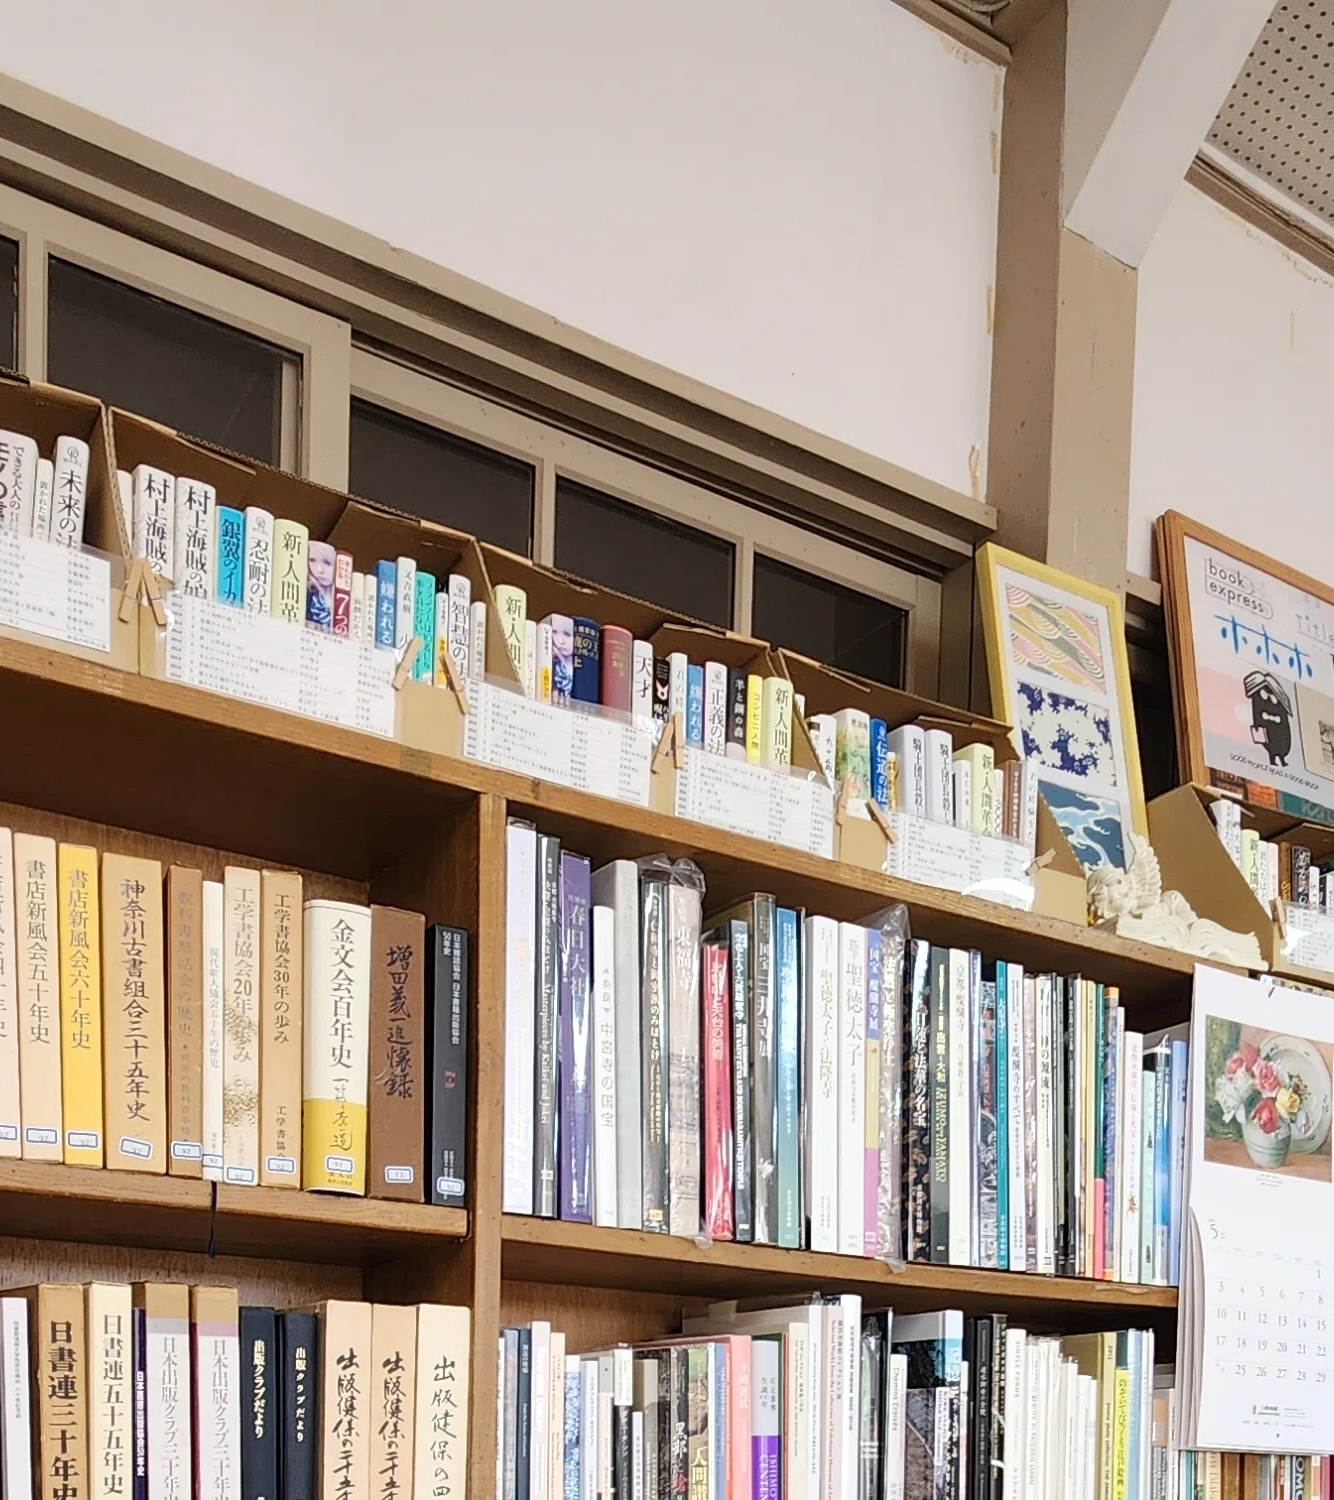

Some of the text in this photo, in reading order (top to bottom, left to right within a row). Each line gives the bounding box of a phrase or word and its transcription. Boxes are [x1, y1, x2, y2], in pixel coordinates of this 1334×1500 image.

[1206, 578, 1267, 616] express
[1207, 556, 1246, 590] book
[25, 859, 51, 1045] 書店新風会五十年史
[67, 868, 92, 1051] 書店新風会六十年史
[119, 878, 152, 1123] 神奈川古書組合三十五年史
[273, 892, 292, 1046] 工学書協会30年の歩み
[330, 918, 357, 1071] 金文会百年史
[844, 961, 864, 1067] 聖徳太子
[1216, 1308, 1227, 1319] 10
[1257, 1313, 1268, 1325] 12
[1297, 1318, 1307, 1329] 14
[1277, 1342, 1327, 1357] 20 22
[101, 1313, 124, 1496] 日書連五十五年史
[252, 1339, 266, 1440] 出版クラブだより
[294, 1346, 307, 1443] 出版クラブだより
[1235, 1364, 1247, 1376] 25
[1276, 1368, 1287, 1380] 27
[1315, 1372, 1327, 1384] 29
